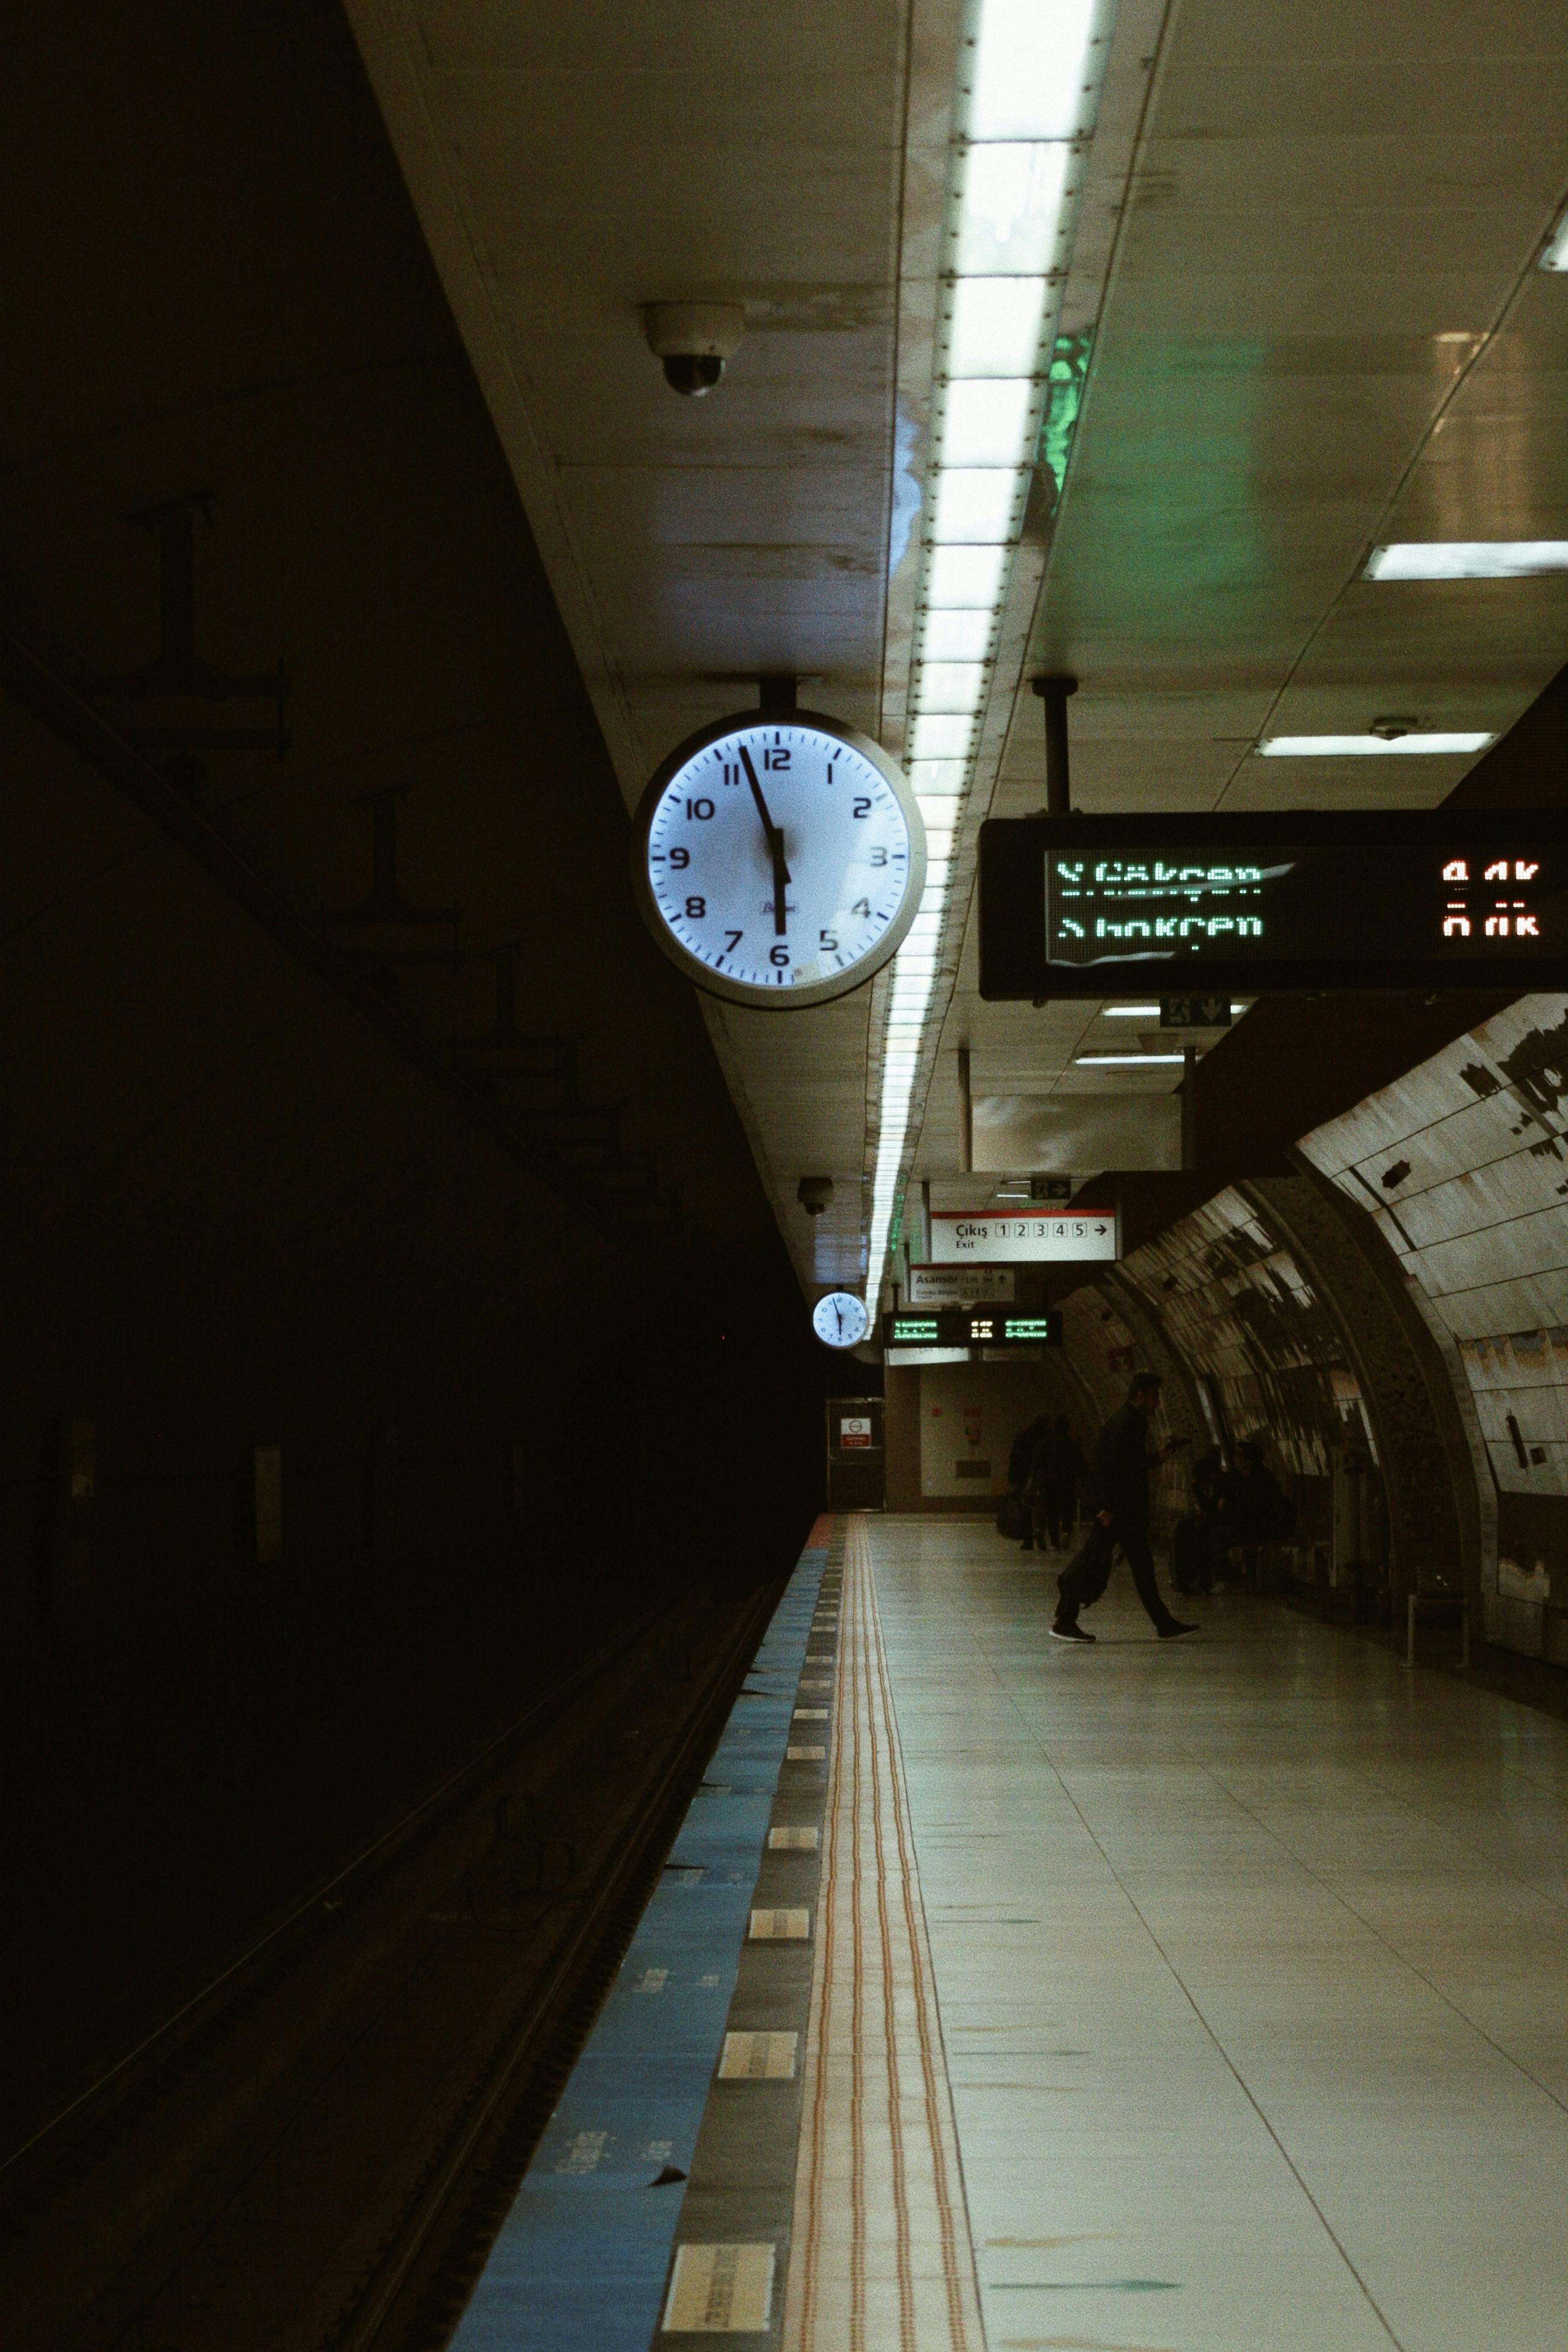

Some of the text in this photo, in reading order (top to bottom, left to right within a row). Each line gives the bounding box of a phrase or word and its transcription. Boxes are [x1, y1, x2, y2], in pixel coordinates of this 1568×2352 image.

[764, 749, 791, 770] 12
[724, 764, 739, 785] 11
[827, 763, 832, 785] 1
[687, 799, 715, 820] 10
[853, 797, 872, 818] 2
[670, 848, 690, 869] 9
[871, 846, 887, 867] 3
[685, 897, 705, 918] 8
[852, 897, 871, 918] 4
[725, 930, 743, 953] 7
[820, 930, 838, 951] 5
[769, 945, 789, 966] 6
[956, 1224, 1084, 1238] Çıkış 1 2 3 4 5
[916, 1275, 958, 1284] Asansör
